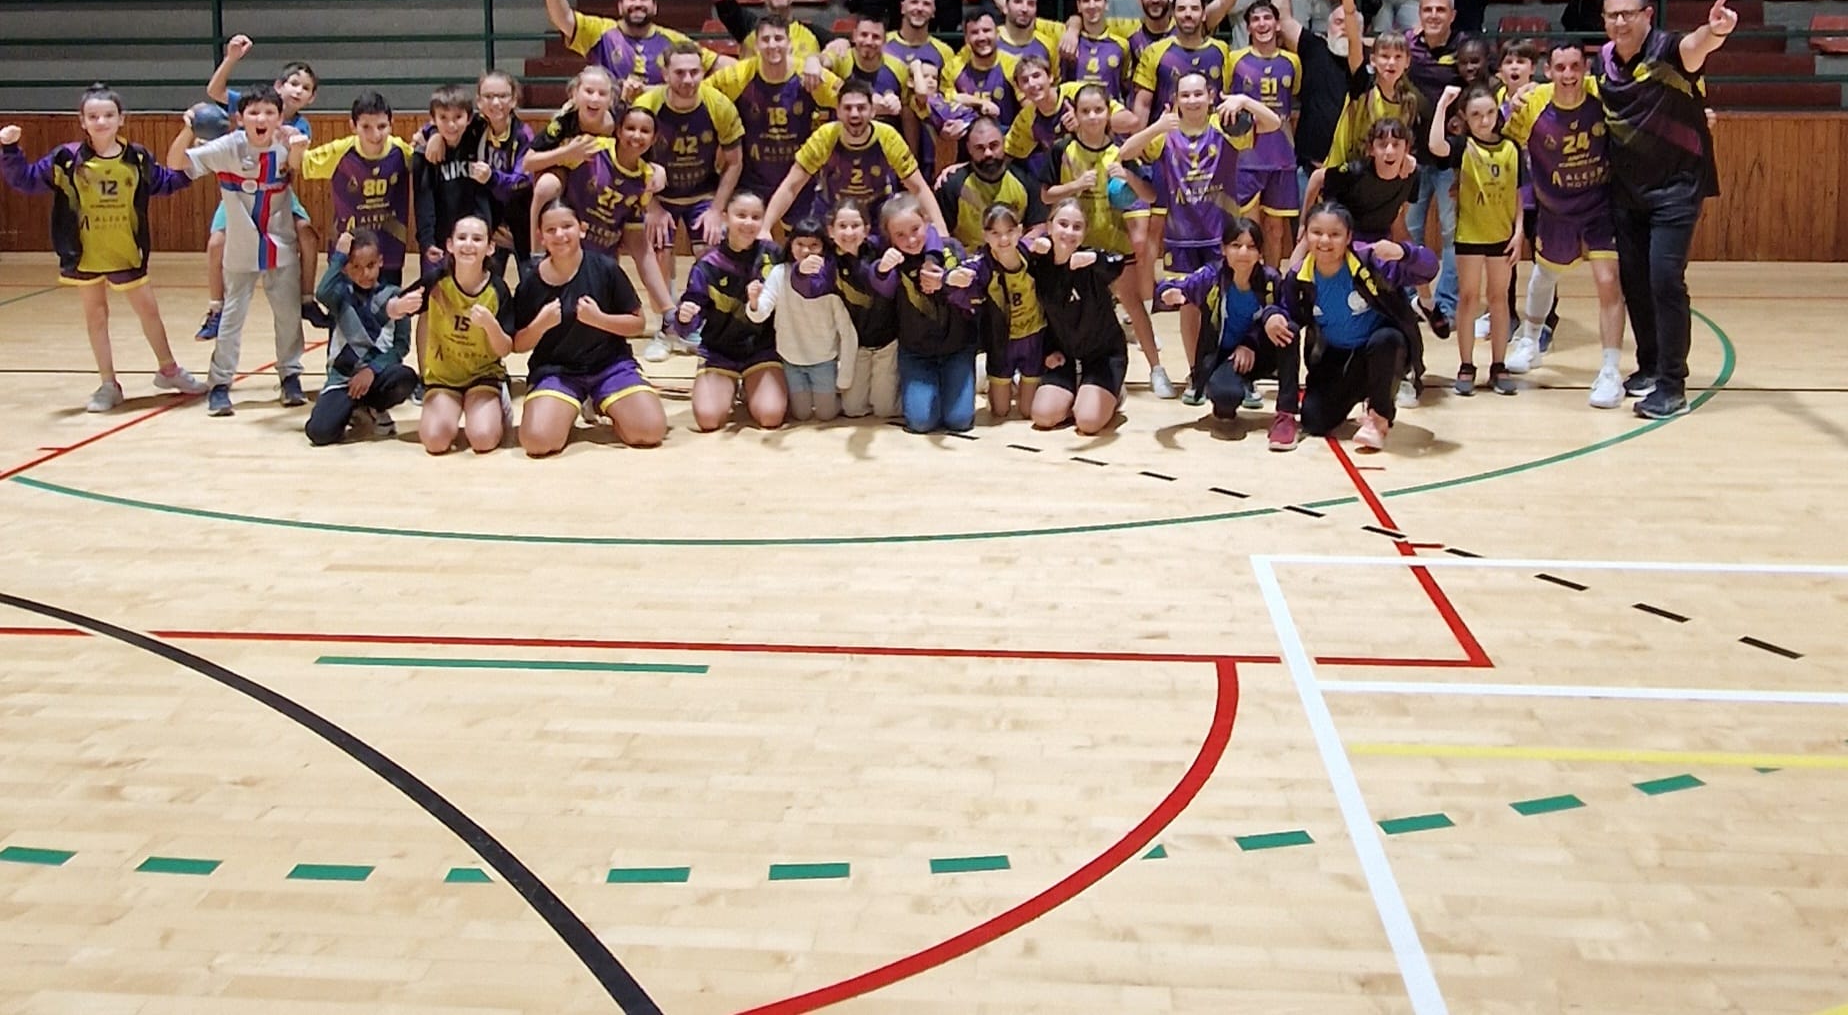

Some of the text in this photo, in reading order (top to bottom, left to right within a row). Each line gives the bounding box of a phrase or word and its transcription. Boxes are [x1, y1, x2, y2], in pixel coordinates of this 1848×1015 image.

[1260, 76, 1278, 95] 31
[766, 106, 788, 126] 18
[673, 135, 699, 155] 42
[1562, 132, 1591, 154] 24
[849, 168, 864, 185] 2
[99, 179, 119, 196] 12
[362, 178, 388, 197] 80
[597, 185, 625, 210] 27
[1012, 292, 1023, 307] 8
[453, 314, 472, 332] 15
